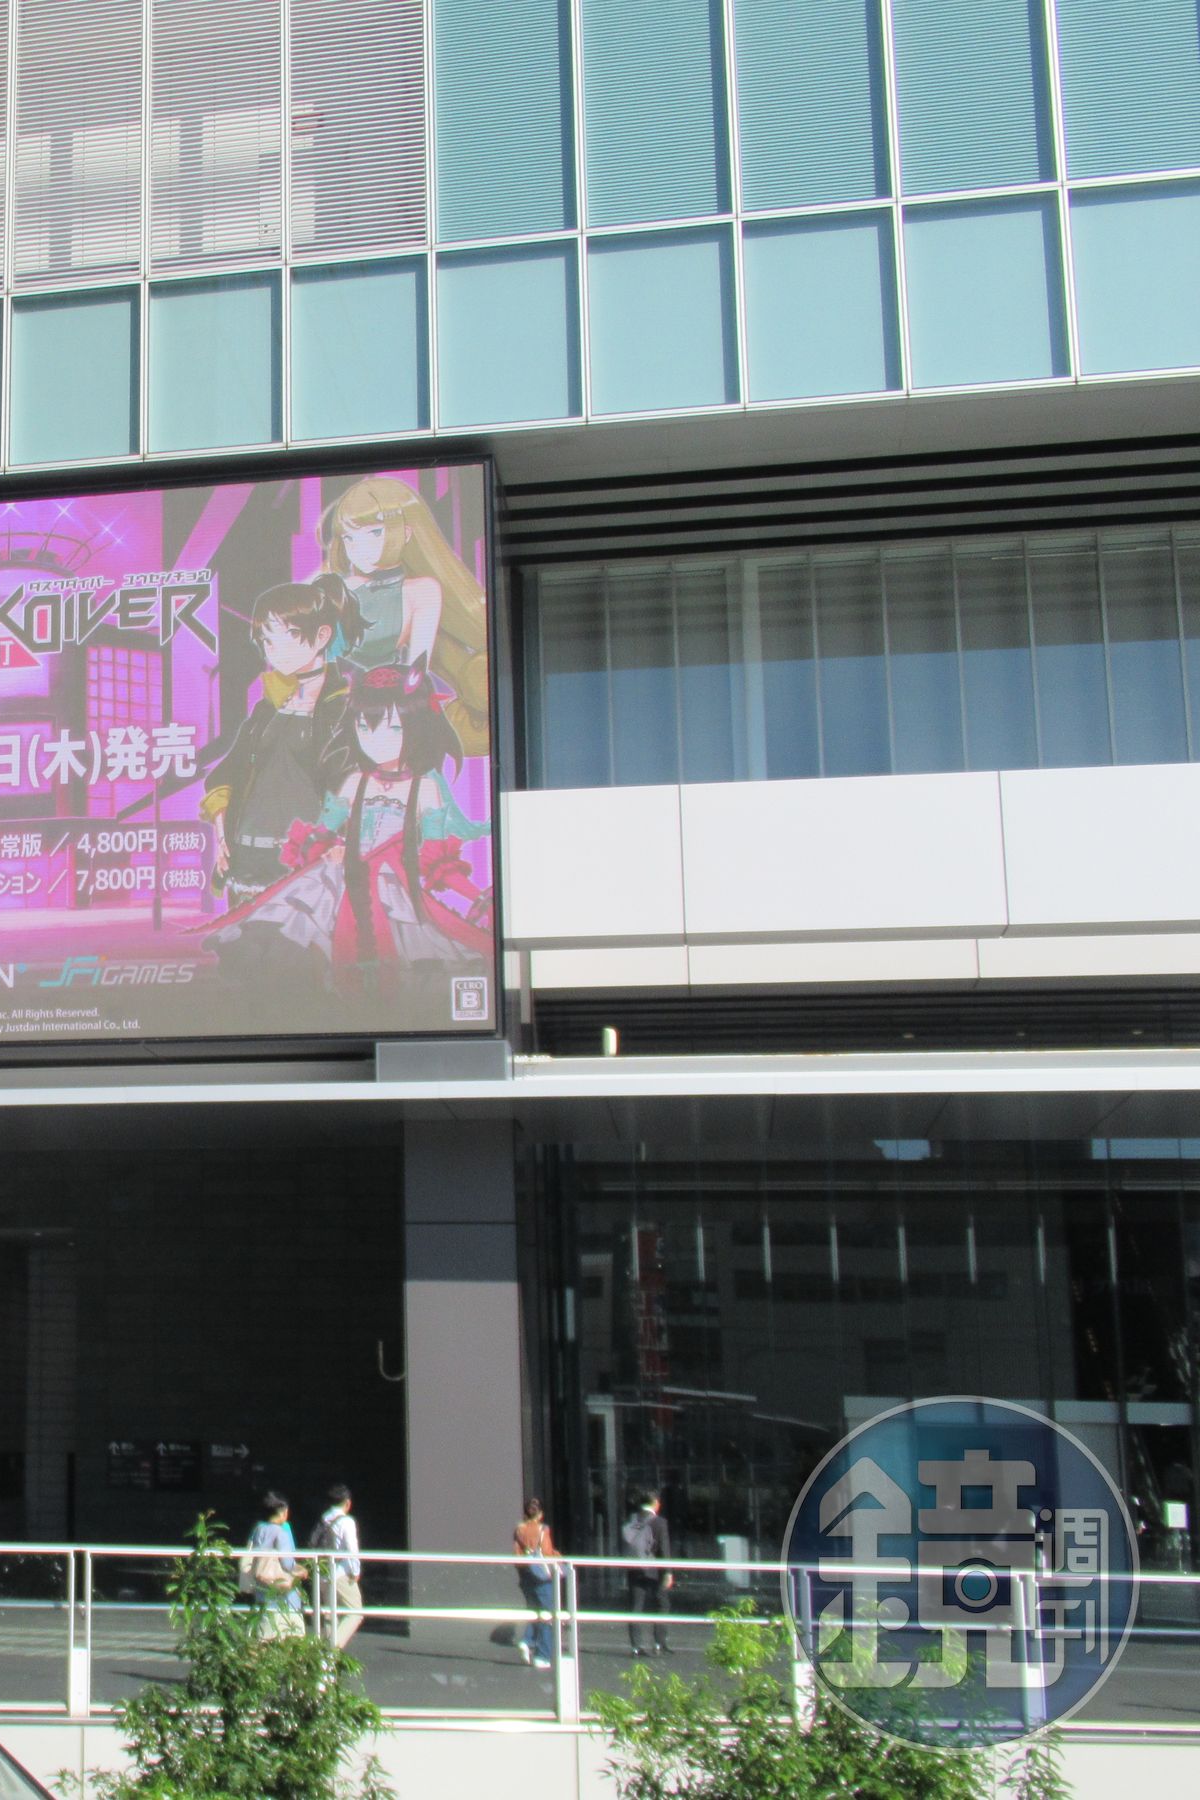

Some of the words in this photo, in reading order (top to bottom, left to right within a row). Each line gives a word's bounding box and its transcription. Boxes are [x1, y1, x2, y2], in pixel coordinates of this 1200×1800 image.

[77, 829, 158, 858] 4,800円
[76, 866, 157, 894] 7,800円
[460, 989, 481, 1009] B
[11, 1009, 24, 1018] All
[25, 1008, 54, 1020] Rights
[55, 1008, 100, 1017] Reserved.
[4, 1022, 40, 1033] Justdan
[42, 1020, 102, 1031] International
[122, 1020, 141, 1029] Ltd.
